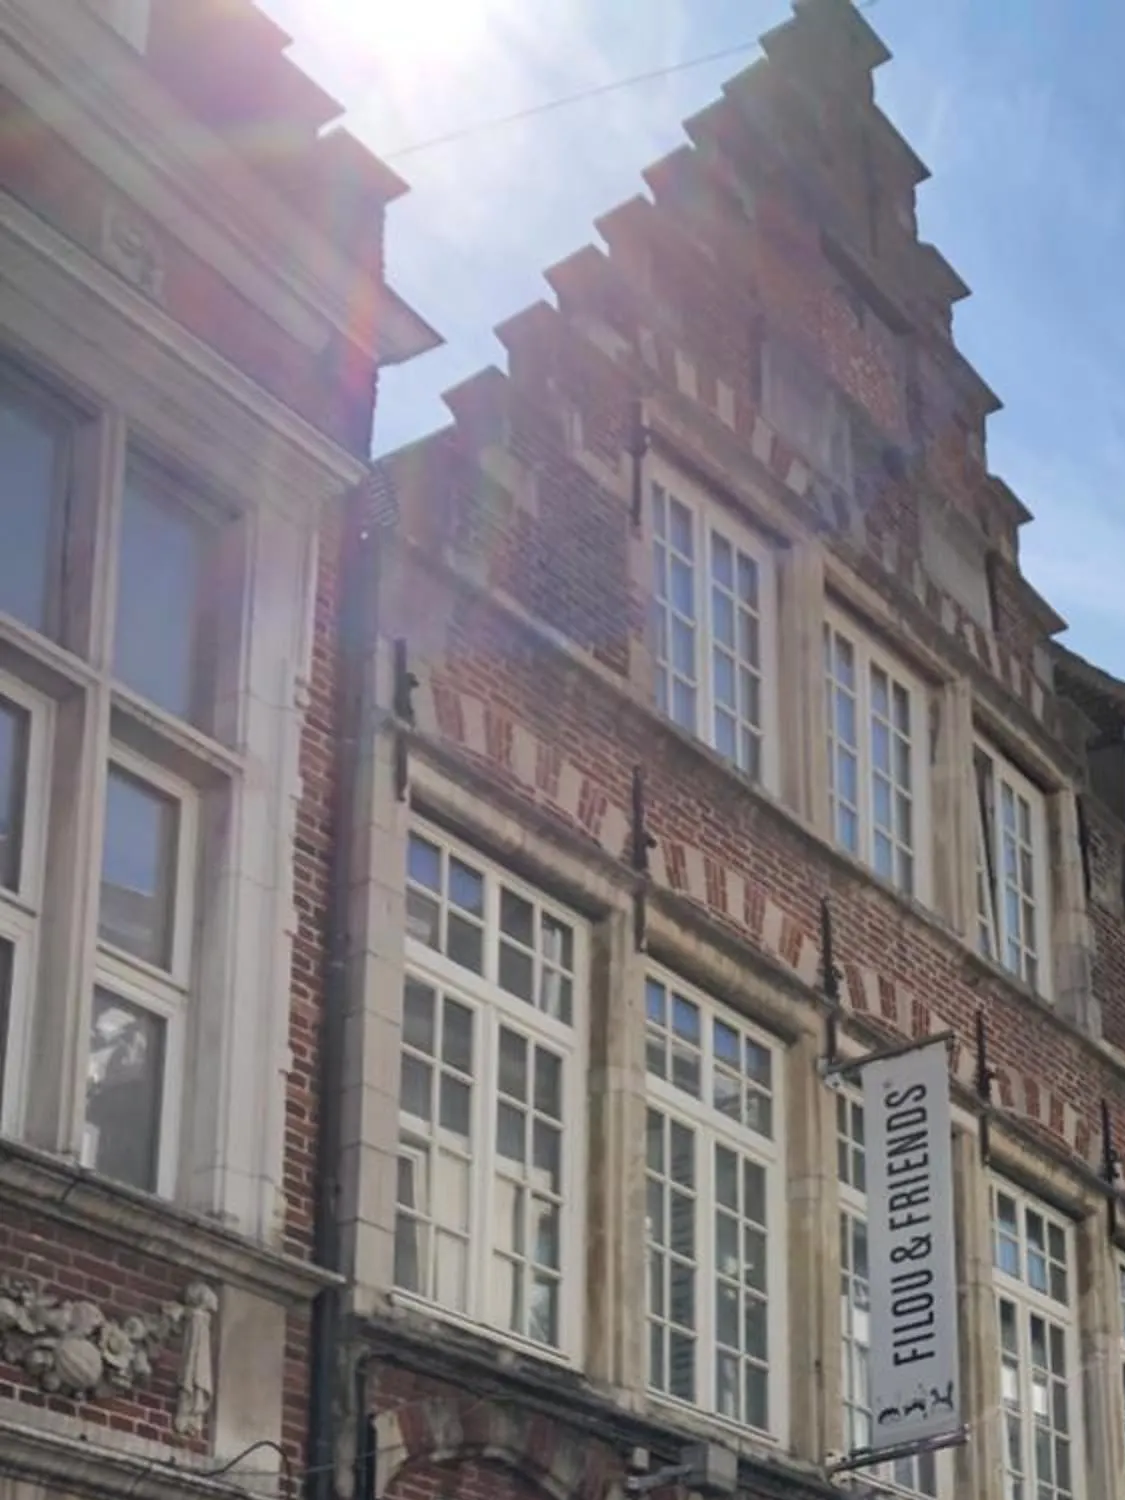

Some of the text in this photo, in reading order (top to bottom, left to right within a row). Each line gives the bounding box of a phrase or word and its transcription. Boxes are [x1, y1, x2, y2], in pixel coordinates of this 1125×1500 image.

[884, 1083, 936, 1367] FILOU & FRIENDS
